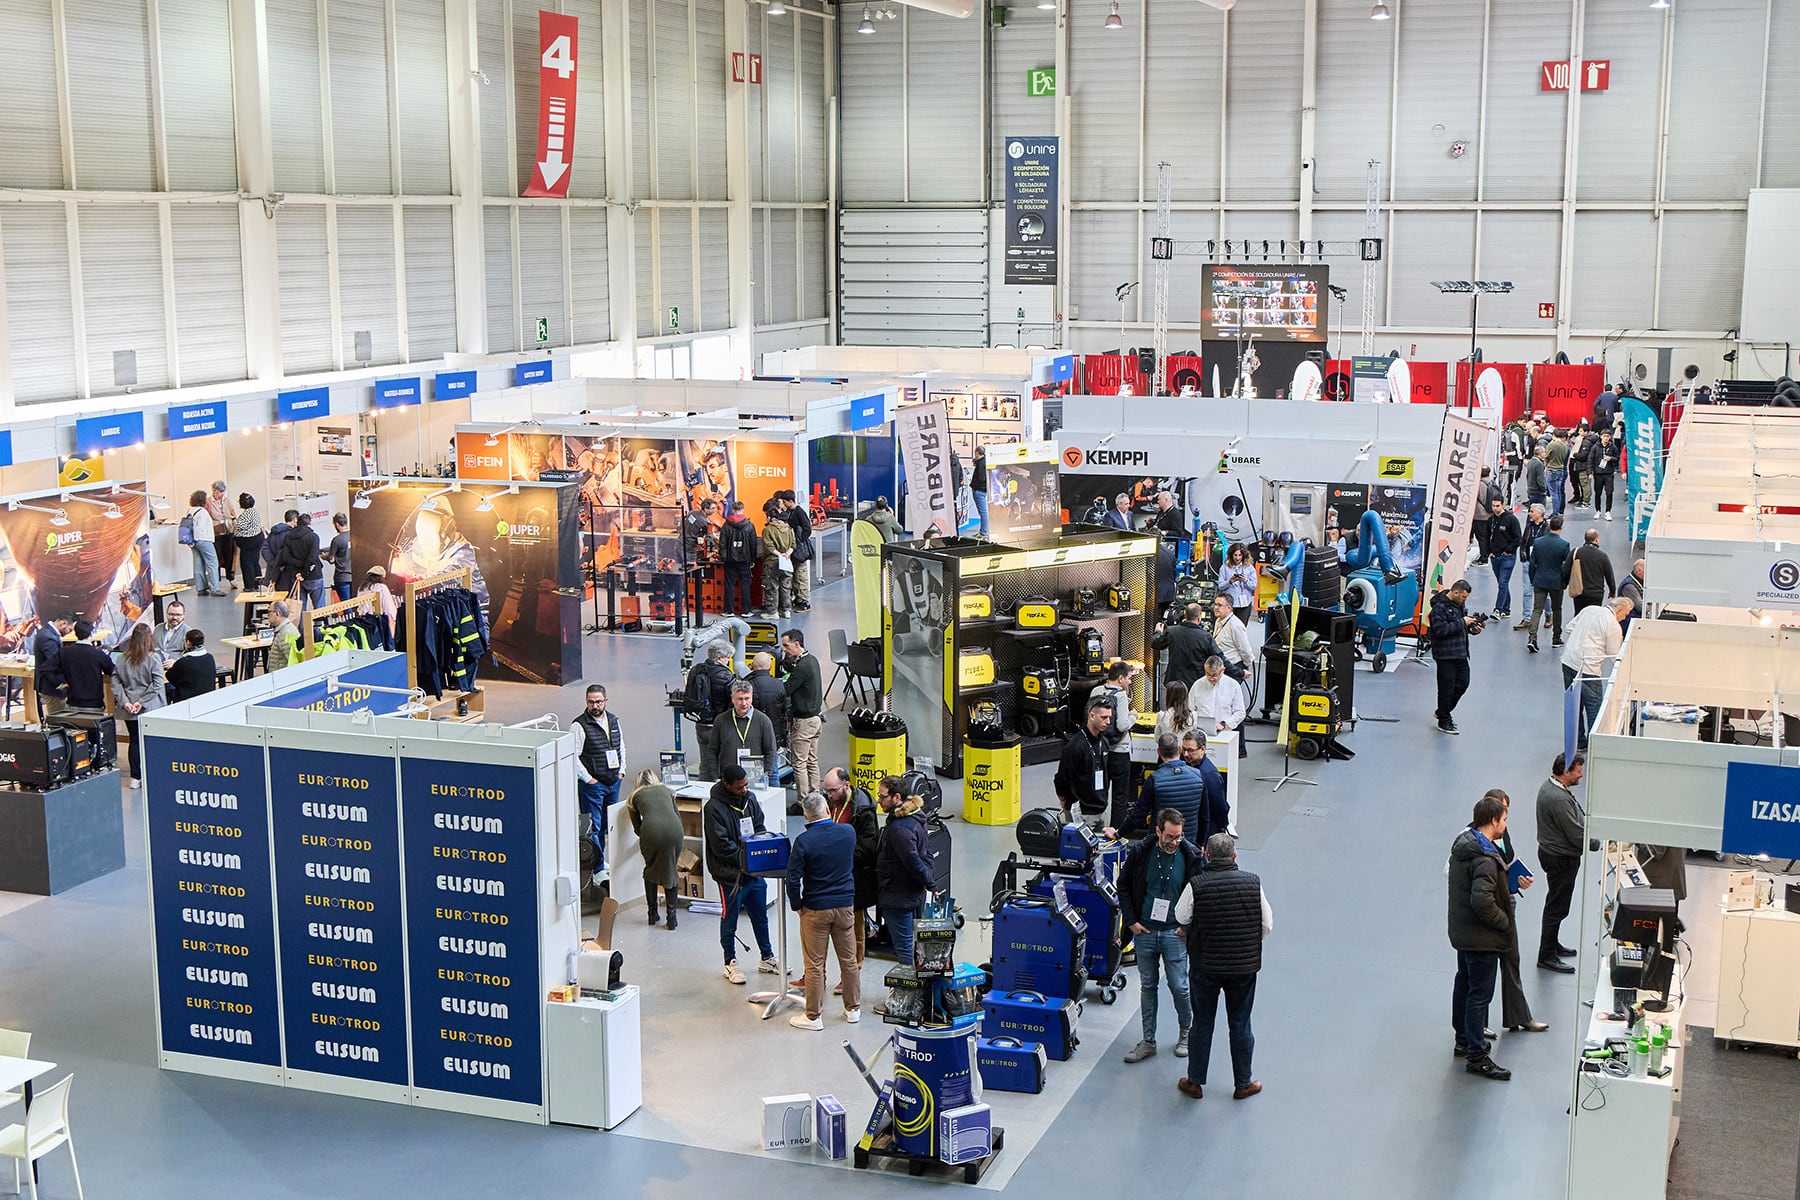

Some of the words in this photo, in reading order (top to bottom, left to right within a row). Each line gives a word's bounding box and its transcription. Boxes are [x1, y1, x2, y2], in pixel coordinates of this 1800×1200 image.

[541, 35, 576, 79] 4
[1026, 145, 1056, 155] unire
[1547, 386, 1588, 399] unire
[477, 457, 503, 467] FEIN
[1085, 449, 1148, 466] KEMPPI
[1231, 456, 1261, 466] UBARE
[758, 466, 787, 477] FEIN
[1386, 463, 1407, 472] ESAB
[1439, 428, 1470, 533] UBARE
[1455, 438, 1482, 536] SOLDADURA
[510, 524, 540, 536] JUPER
[57, 531, 83, 547] JUPER
[1756, 591, 1800, 599] SPECIALIZED
[172, 762, 238, 777] EUROTROD
[852, 768, 888, 780] MARATHON
[299, 774, 368, 790] EUROTROD
[857, 780, 874, 791] PAC
[966, 778, 1004, 790] MARATHON
[176, 789, 238, 810] ELISUM
[432, 784, 504, 800] EUROTROD
[972, 791, 990, 802] PAC
[302, 802, 367, 822] ELISUM
[1751, 800, 1800, 823] IZASA
[176, 822, 241, 837] EUROTROD
[434, 813, 502, 834] ELISUM
[302, 835, 371, 851] EUROTROD
[179, 849, 241, 869] ELISUM
[434, 847, 506, 863] EUROTROD
[306, 863, 370, 883] ELISUM
[179, 881, 245, 897] EUROTROD
[437, 875, 504, 896] ELISUM
[305, 895, 374, 911] EUROTROD
[183, 908, 245, 928] ELISUM
[436, 908, 508, 925] EUROTROD
[309, 923, 373, 943] ELISUM
[183, 940, 248, 956] EUROTROD
[439, 937, 506, 958] ELISUM
[1010, 942, 1054, 953] EUROTROD
[309, 955, 377, 972] EUROTROD
[186, 967, 248, 987] ELISUM
[439, 969, 511, 986] EUROTROD
[312, 982, 376, 1003] ELISUM
[187, 997, 252, 1014] EUROTROD
[442, 997, 508, 1019] ELISUM
[312, 1013, 380, 1030] EUROTROD
[1000, 1020, 1045, 1033] EUROTROD
[190, 1024, 252, 1045] ELISUM
[441, 1029, 512, 1047] EUROTROD
[316, 1041, 378, 1063] ELISUM
[444, 1057, 510, 1079] ELISUM
